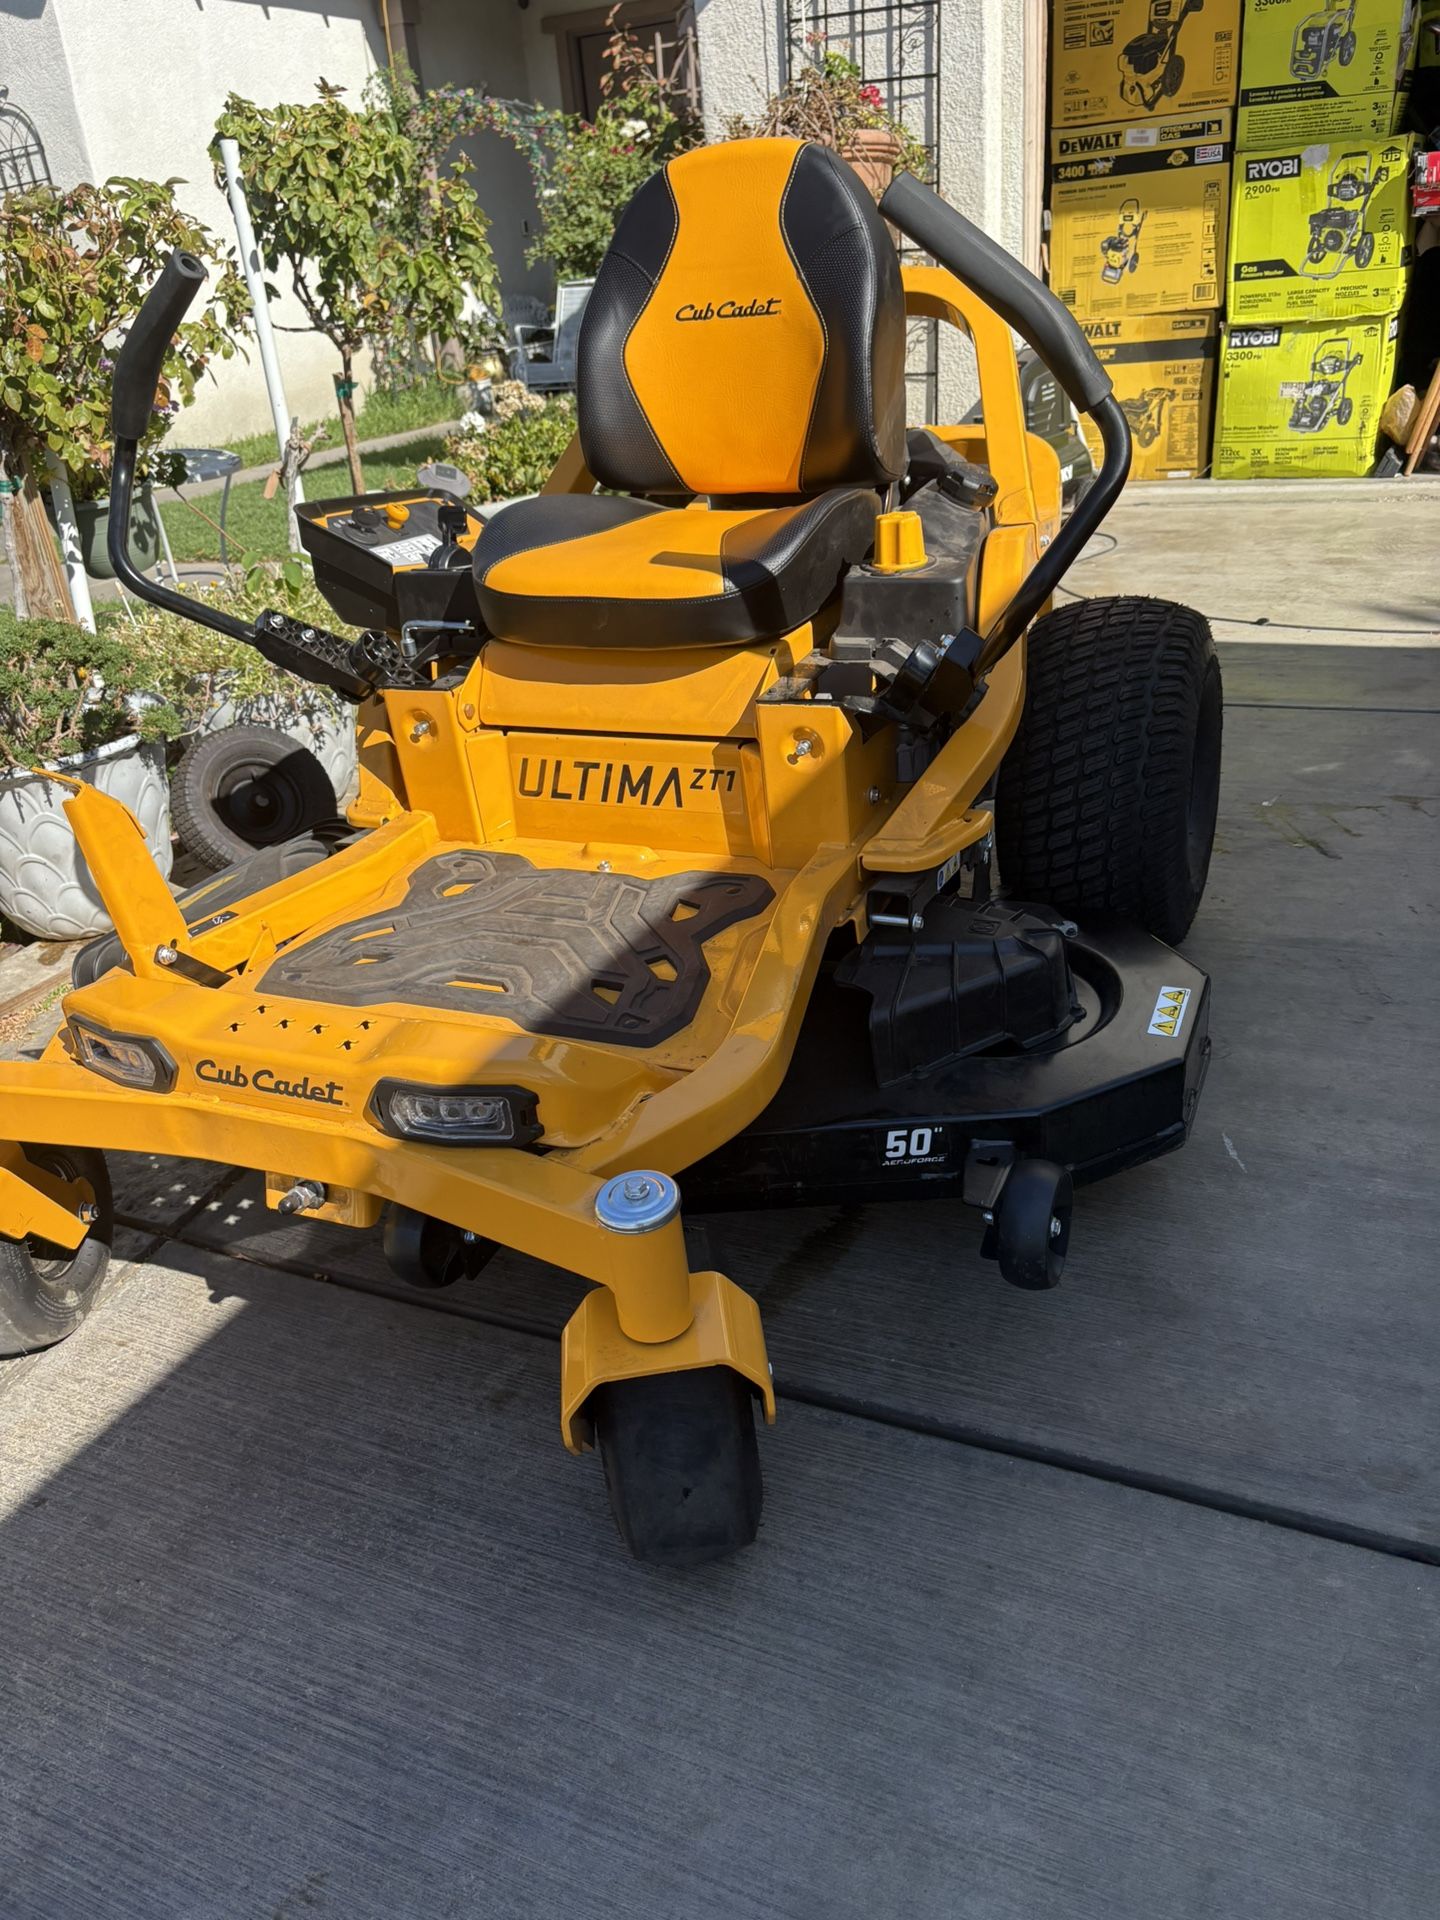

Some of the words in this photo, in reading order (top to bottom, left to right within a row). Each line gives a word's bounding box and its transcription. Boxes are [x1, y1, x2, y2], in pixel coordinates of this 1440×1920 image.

[1161, 132, 1181, 140] GAS
[1207, 150, 1221, 159] USA
[1383, 153, 1400, 162] UP
[1058, 165, 1085, 179] 3400
[1248, 158, 1298, 178] RYOBI
[1241, 265, 1257, 273] Gas
[1373, 288, 1379, 297] 3
[676, 303, 714, 321] Cub
[717, 298, 781, 318] Cadet
[1231, 330, 1279, 347] RYOBI
[519, 758, 683, 808] ULTIMA
[690, 768, 736, 792] ZT1
[196, 1059, 248, 1088] Cub
[252, 1069, 344, 1106] Cadet
[885, 1127, 942, 1158] 50"
